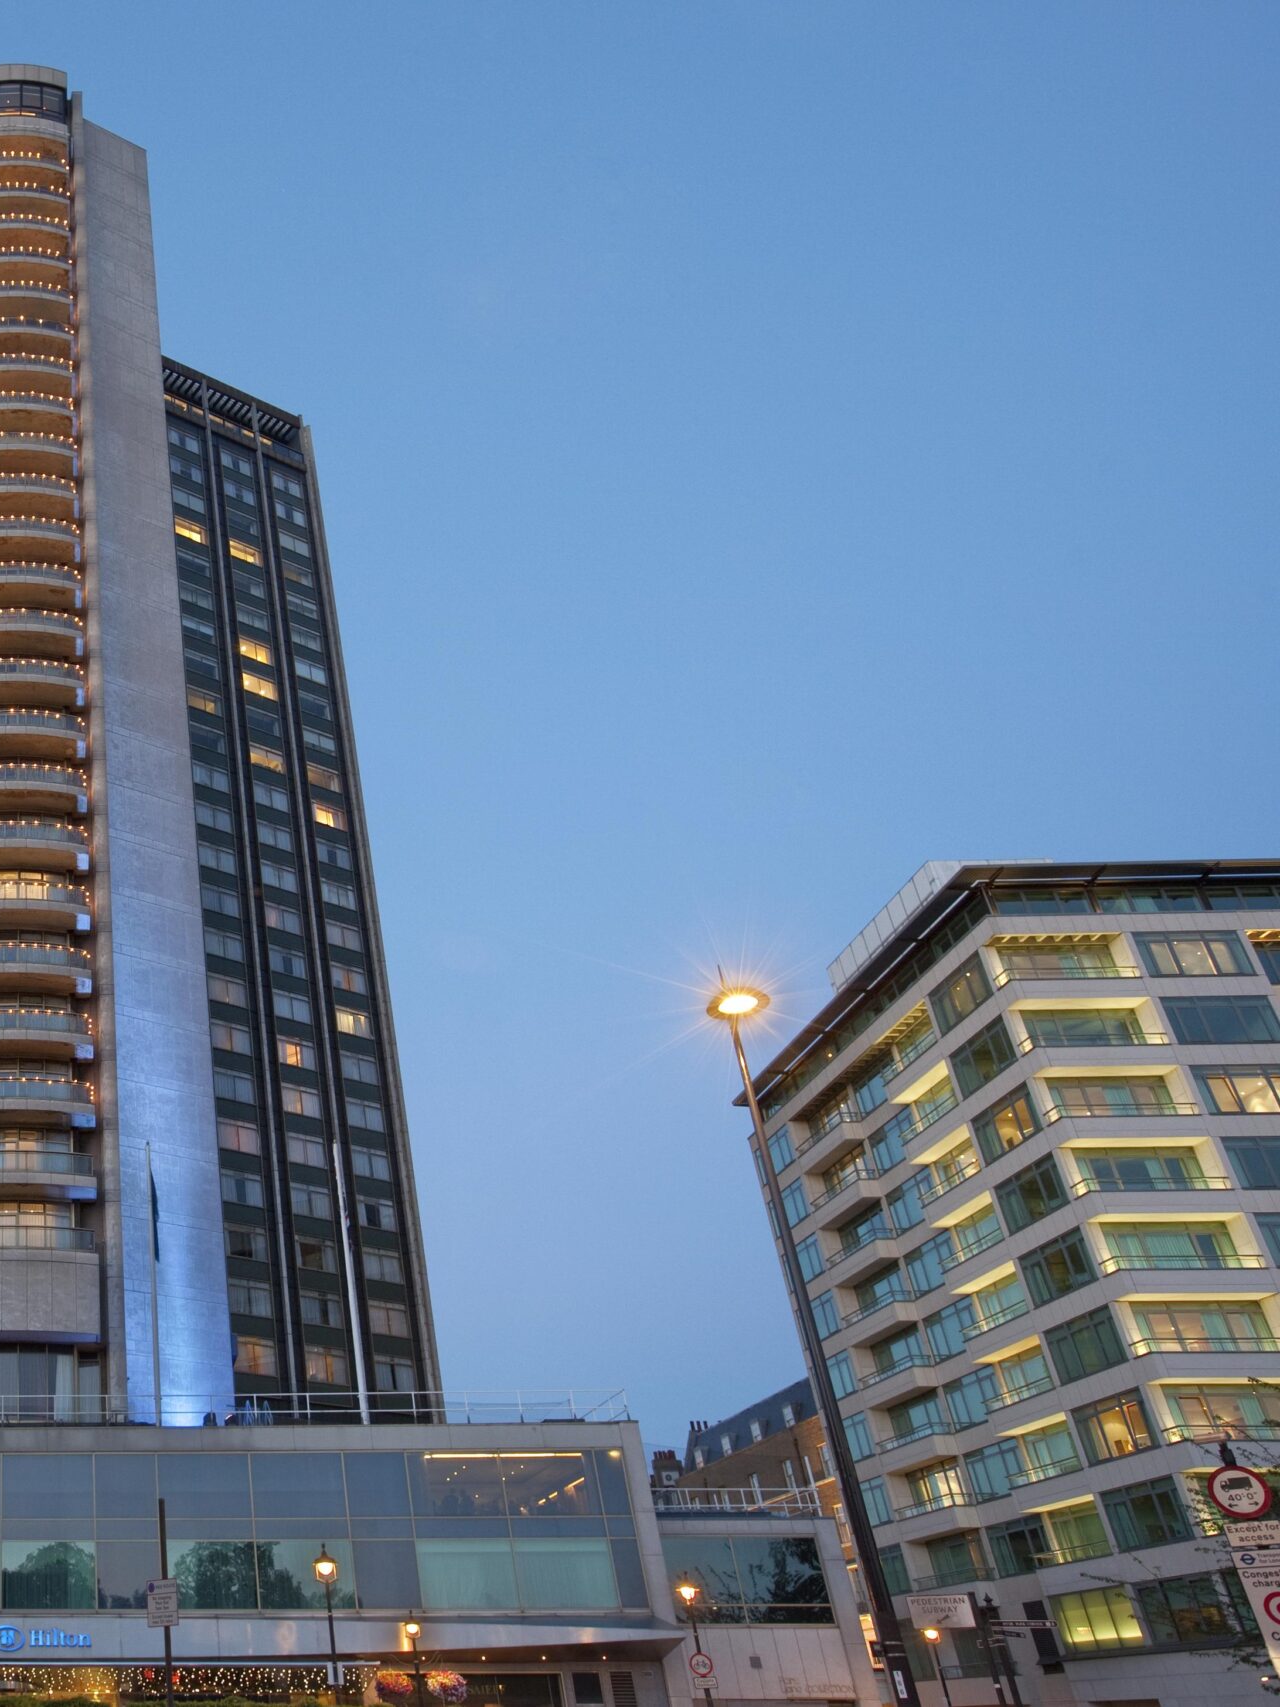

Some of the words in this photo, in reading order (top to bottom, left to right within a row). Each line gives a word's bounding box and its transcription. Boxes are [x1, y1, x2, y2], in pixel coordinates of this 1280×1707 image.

[1227, 1525, 1263, 1533] Except
[1265, 1523, 1280, 1531] for
[1239, 1534, 1275, 1542] access
[911, 1597, 966, 1606] PEDESTRIAN
[922, 1606, 959, 1614] SUBWAY
[29, 1627, 92, 1647] Hilton
